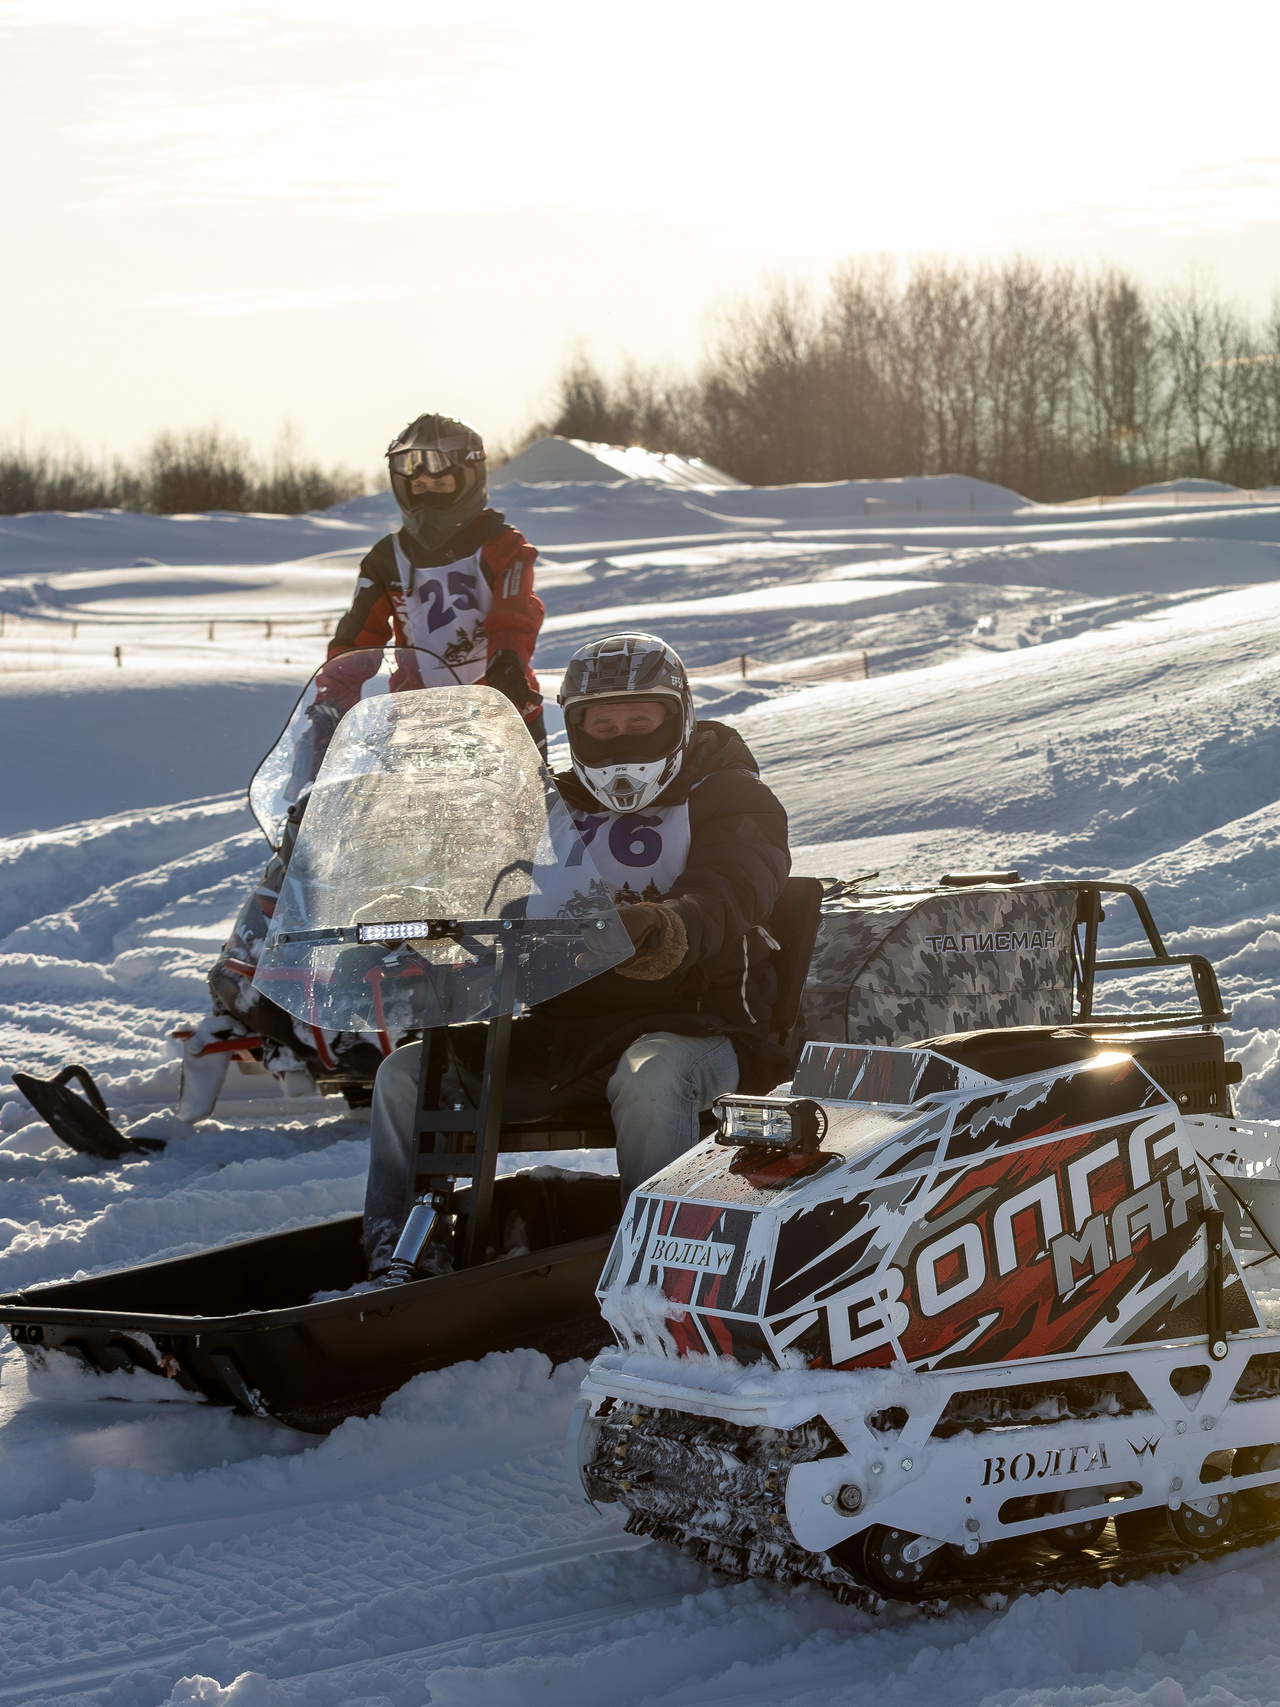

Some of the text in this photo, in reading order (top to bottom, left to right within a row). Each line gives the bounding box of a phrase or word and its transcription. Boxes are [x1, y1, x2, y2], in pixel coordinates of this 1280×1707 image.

[418, 570, 478, 634] 25
[565, 813, 664, 868] 76
[925, 929, 1058, 955] ТАЛИСМАН
[650, 1239, 712, 1267] ВОЛГА
[980, 1442, 1112, 1486] ВОЛГА
